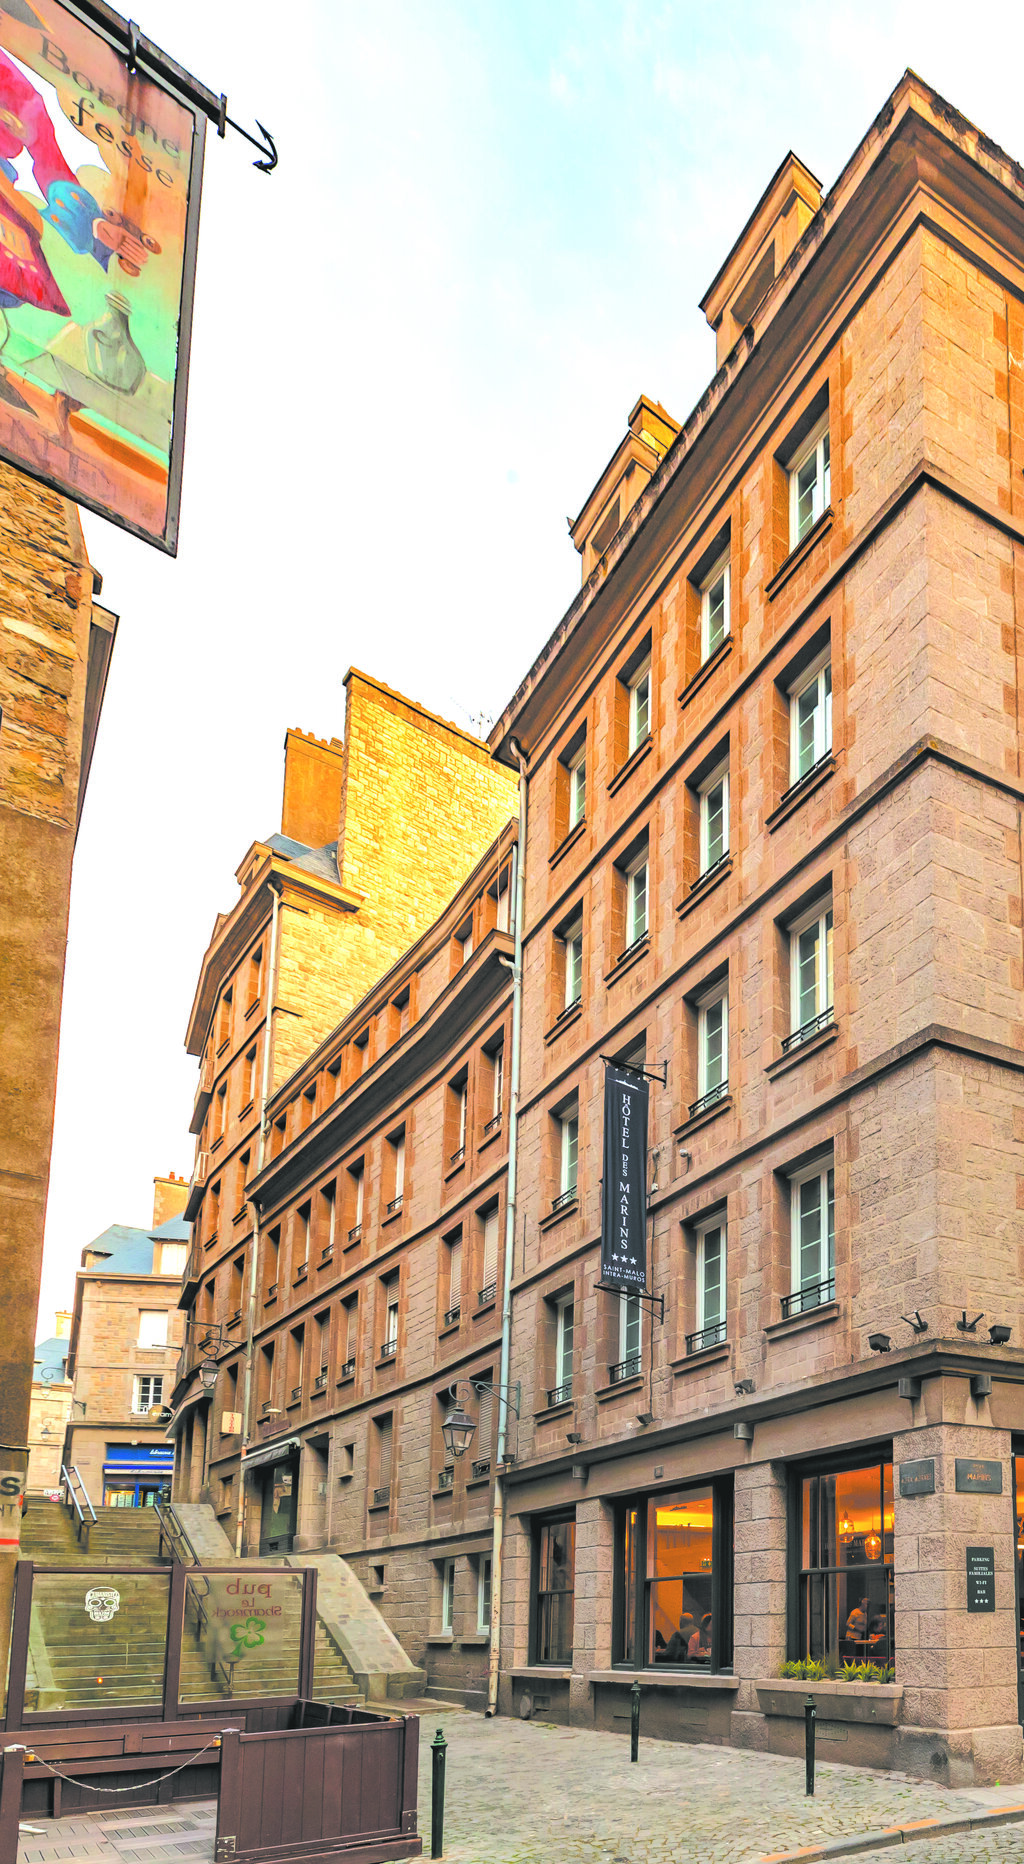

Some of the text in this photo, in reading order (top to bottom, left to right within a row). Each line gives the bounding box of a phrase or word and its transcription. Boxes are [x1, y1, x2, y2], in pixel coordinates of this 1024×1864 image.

[38, 32, 180, 159] Borgne
[69, 97, 174, 189] fesse
[619, 1093, 631, 1250] HÔTEL DES MARINS
[603, 1264, 645, 1277] SAINT-MALO
[603, 1270, 645, 1283] INTRA-MUROS
